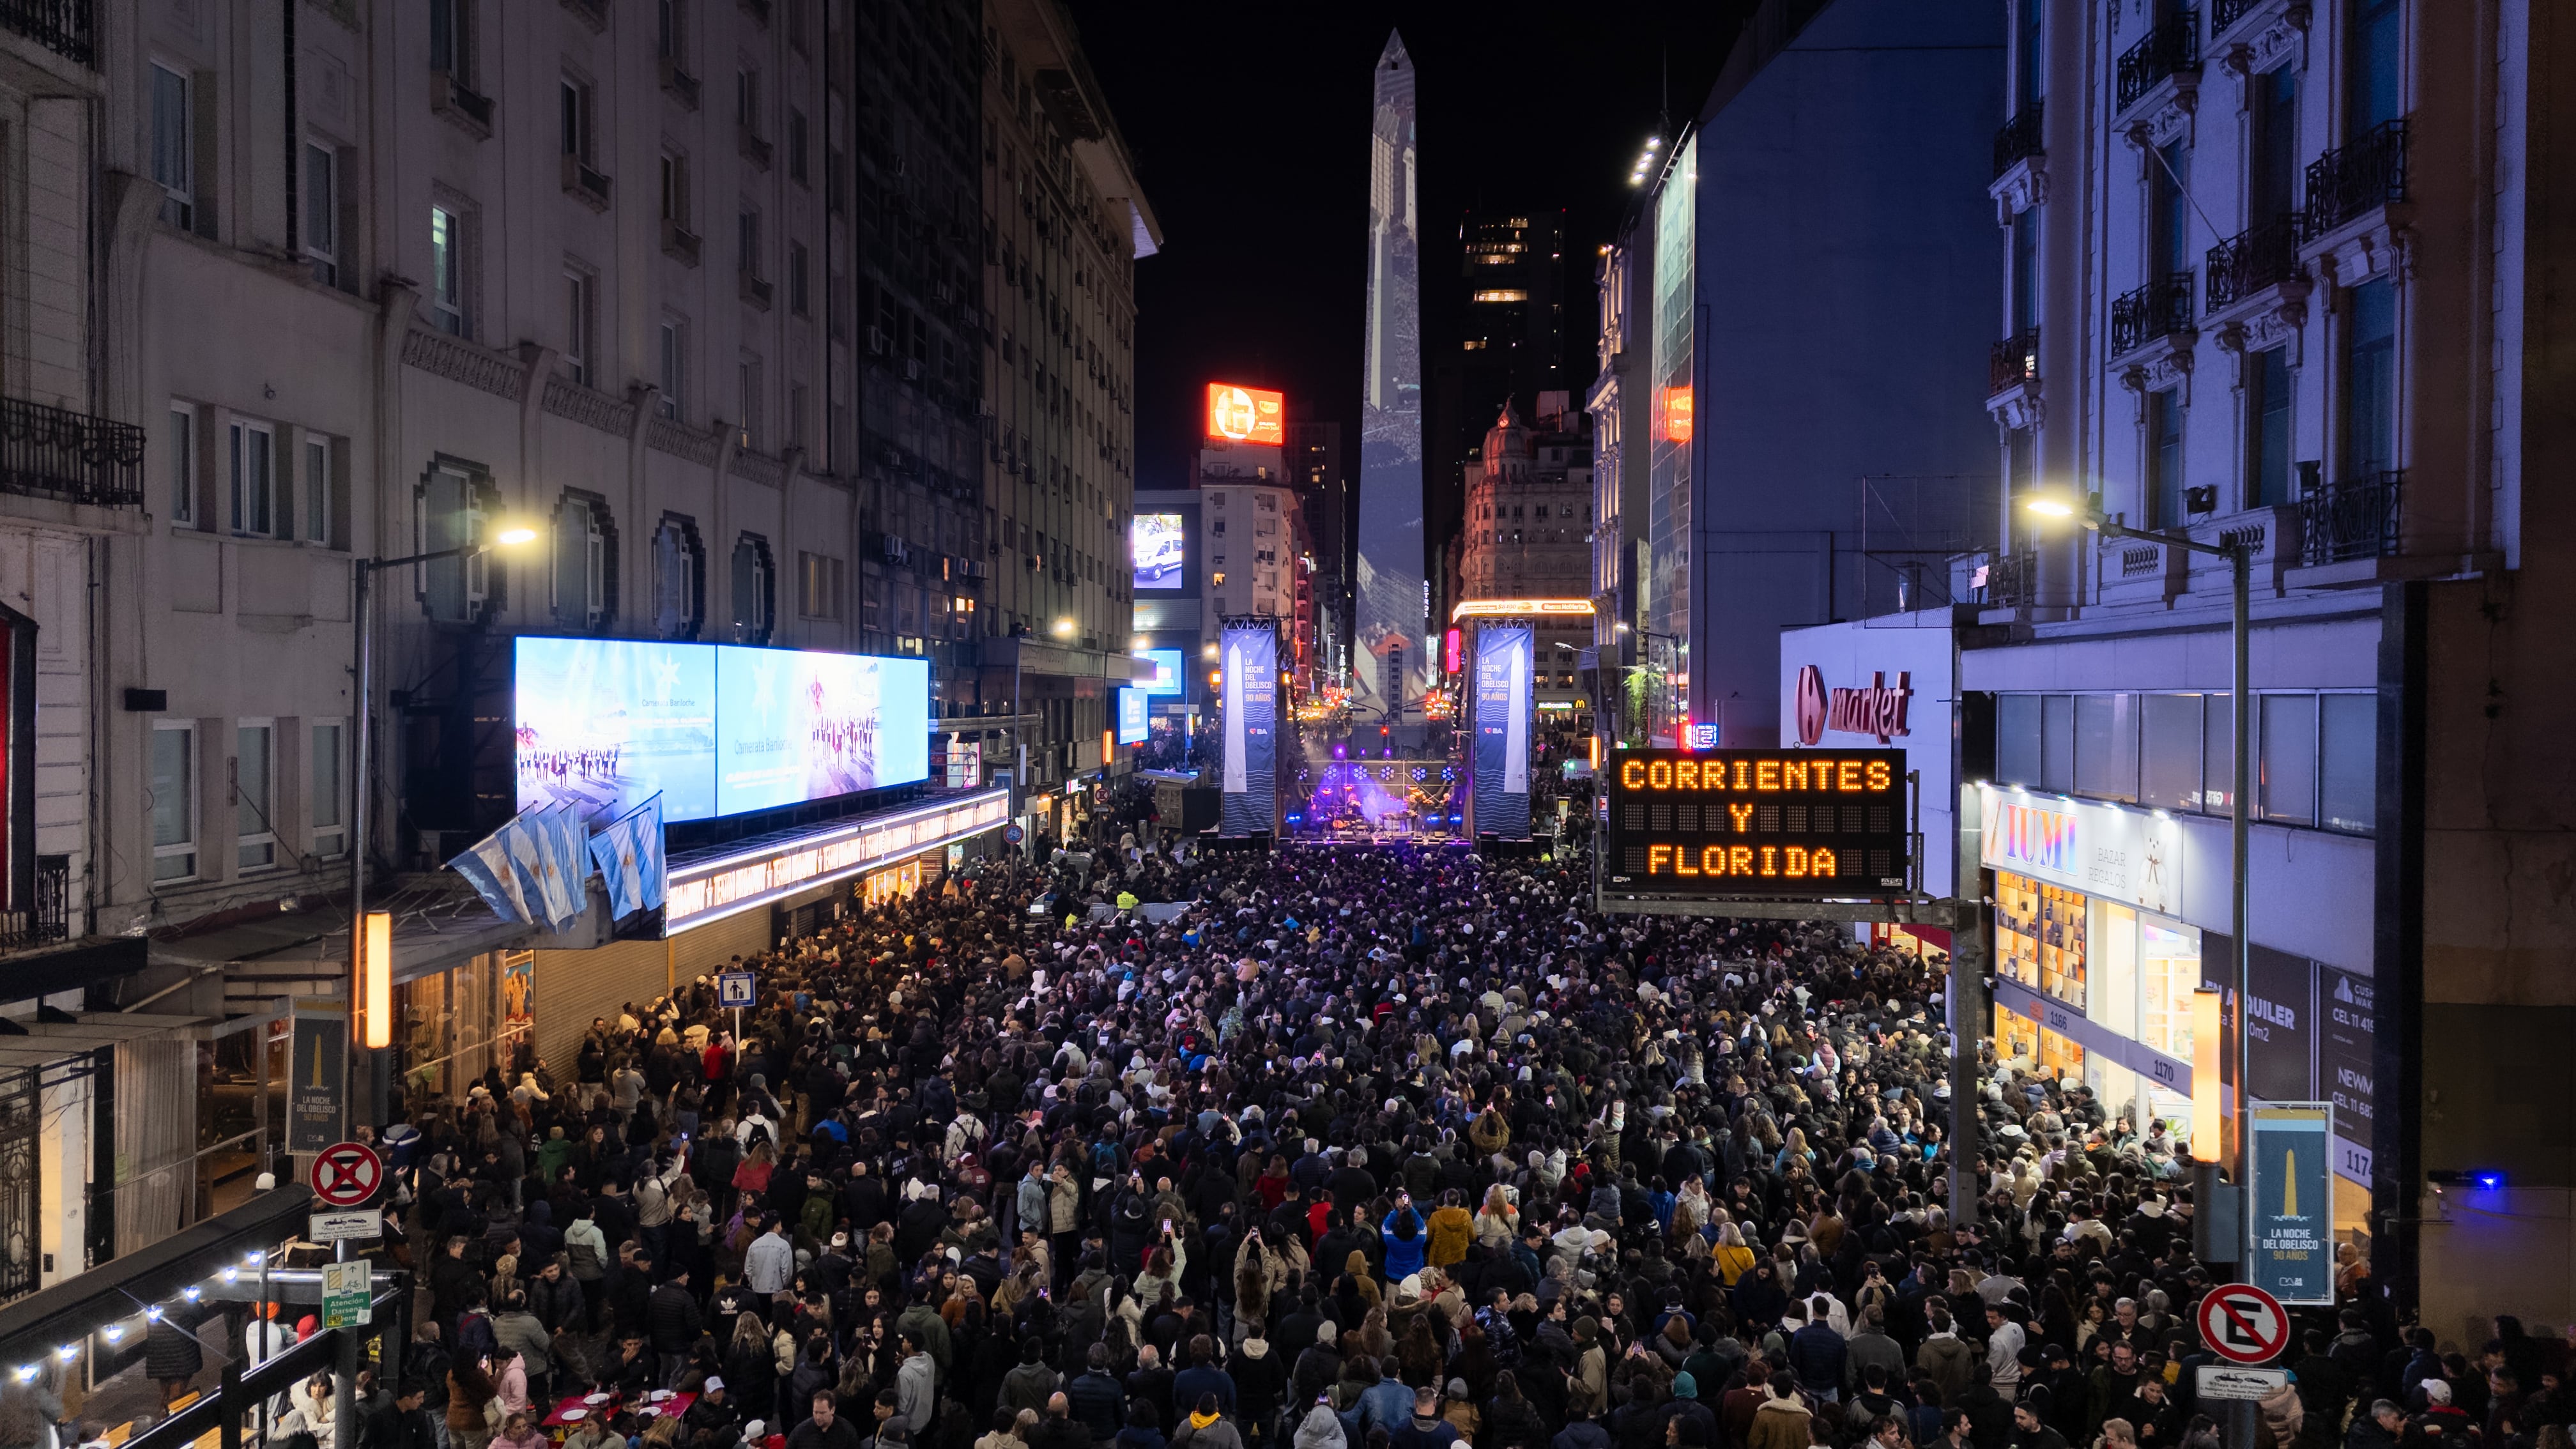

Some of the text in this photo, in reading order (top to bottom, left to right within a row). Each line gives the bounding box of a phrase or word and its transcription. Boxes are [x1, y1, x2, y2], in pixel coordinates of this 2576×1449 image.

[1481, 680, 1509, 688] OBELISCO
[670, 698, 695, 707] Bariloche
[1255, 693, 1271, 702] AÑOS
[1482, 692, 1508, 701] 90 AÑOS
[1829, 671, 1913, 745] market
[735, 738, 765, 755] Camerata
[1623, 760, 1890, 790] CORRIENTES
[1729, 803, 1753, 833] Y
[2007, 803, 2078, 876] IUMI
[1650, 845, 1836, 877] FLORIDA
[2098, 848, 2126, 867] BAZAR
[2089, 866, 2126, 889] REGALOS
[2226, 988, 2296, 1030] AQUILER
[2333, 1008, 2350, 1025] CEL
[2351, 1014, 2359, 1027] 11
[2050, 1011, 2067, 1030] 1166
[2154, 1059, 2174, 1082] 1170
[296, 1103, 336, 1114] DEL OBELISCO
[303, 1095, 331, 1105] LA NOCHE
[2333, 1091, 2349, 1108] CEL
[2350, 1098, 2357, 1112] 11
[2271, 1228, 2311, 1239] LA NOCHE
[2262, 1239, 2319, 1250] DEL OBELISCO
[2273, 1248, 2308, 1261] 90 AÑOS
[330, 1298, 364, 1307] Atención
